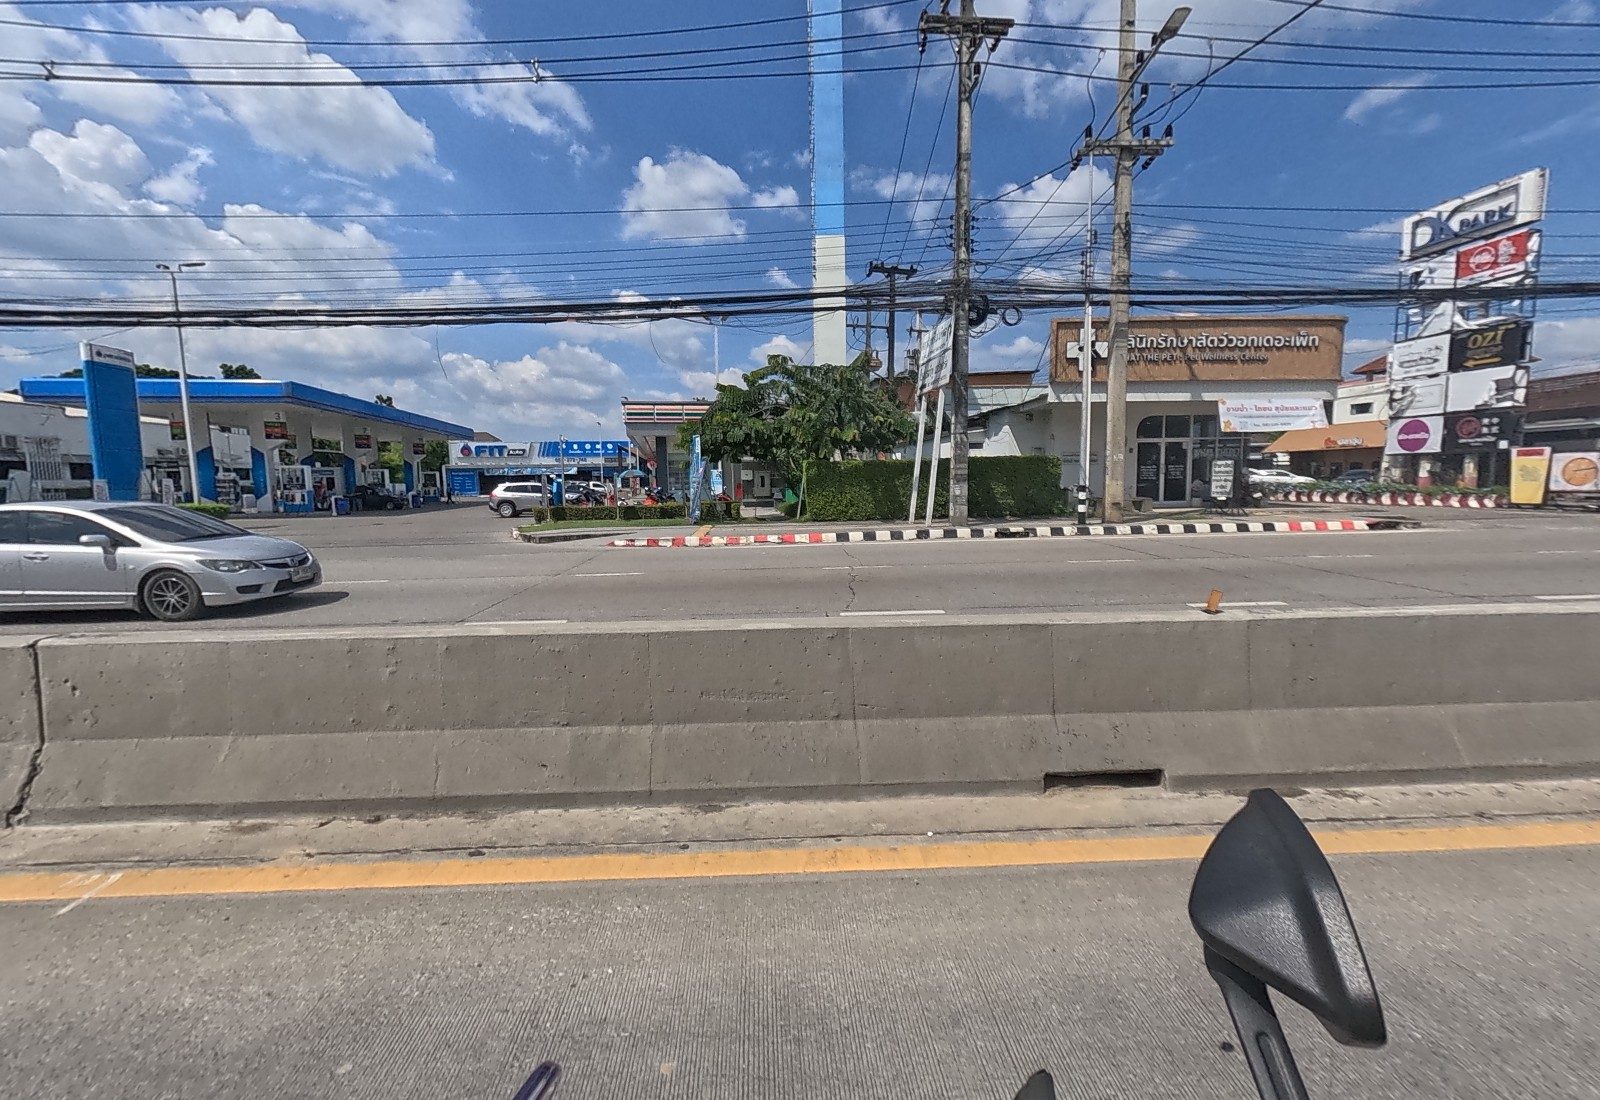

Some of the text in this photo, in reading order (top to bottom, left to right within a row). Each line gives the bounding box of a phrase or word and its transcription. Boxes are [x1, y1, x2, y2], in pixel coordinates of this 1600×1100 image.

[1458, 202, 1515, 233] PARK
[1127, 331, 1319, 348] ลินิกรักษาสัตว์วอทเดอะเพ็ท
[1143, 353, 1159, 361] THE
[1162, 353, 1178, 361] PET
[1185, 353, 1200, 361] Pet
[1201, 352, 1238, 361] Wellness
[1240, 352, 1268, 361] Center
[274, 412, 281, 420] 3
[474, 445, 508, 457] FIT
